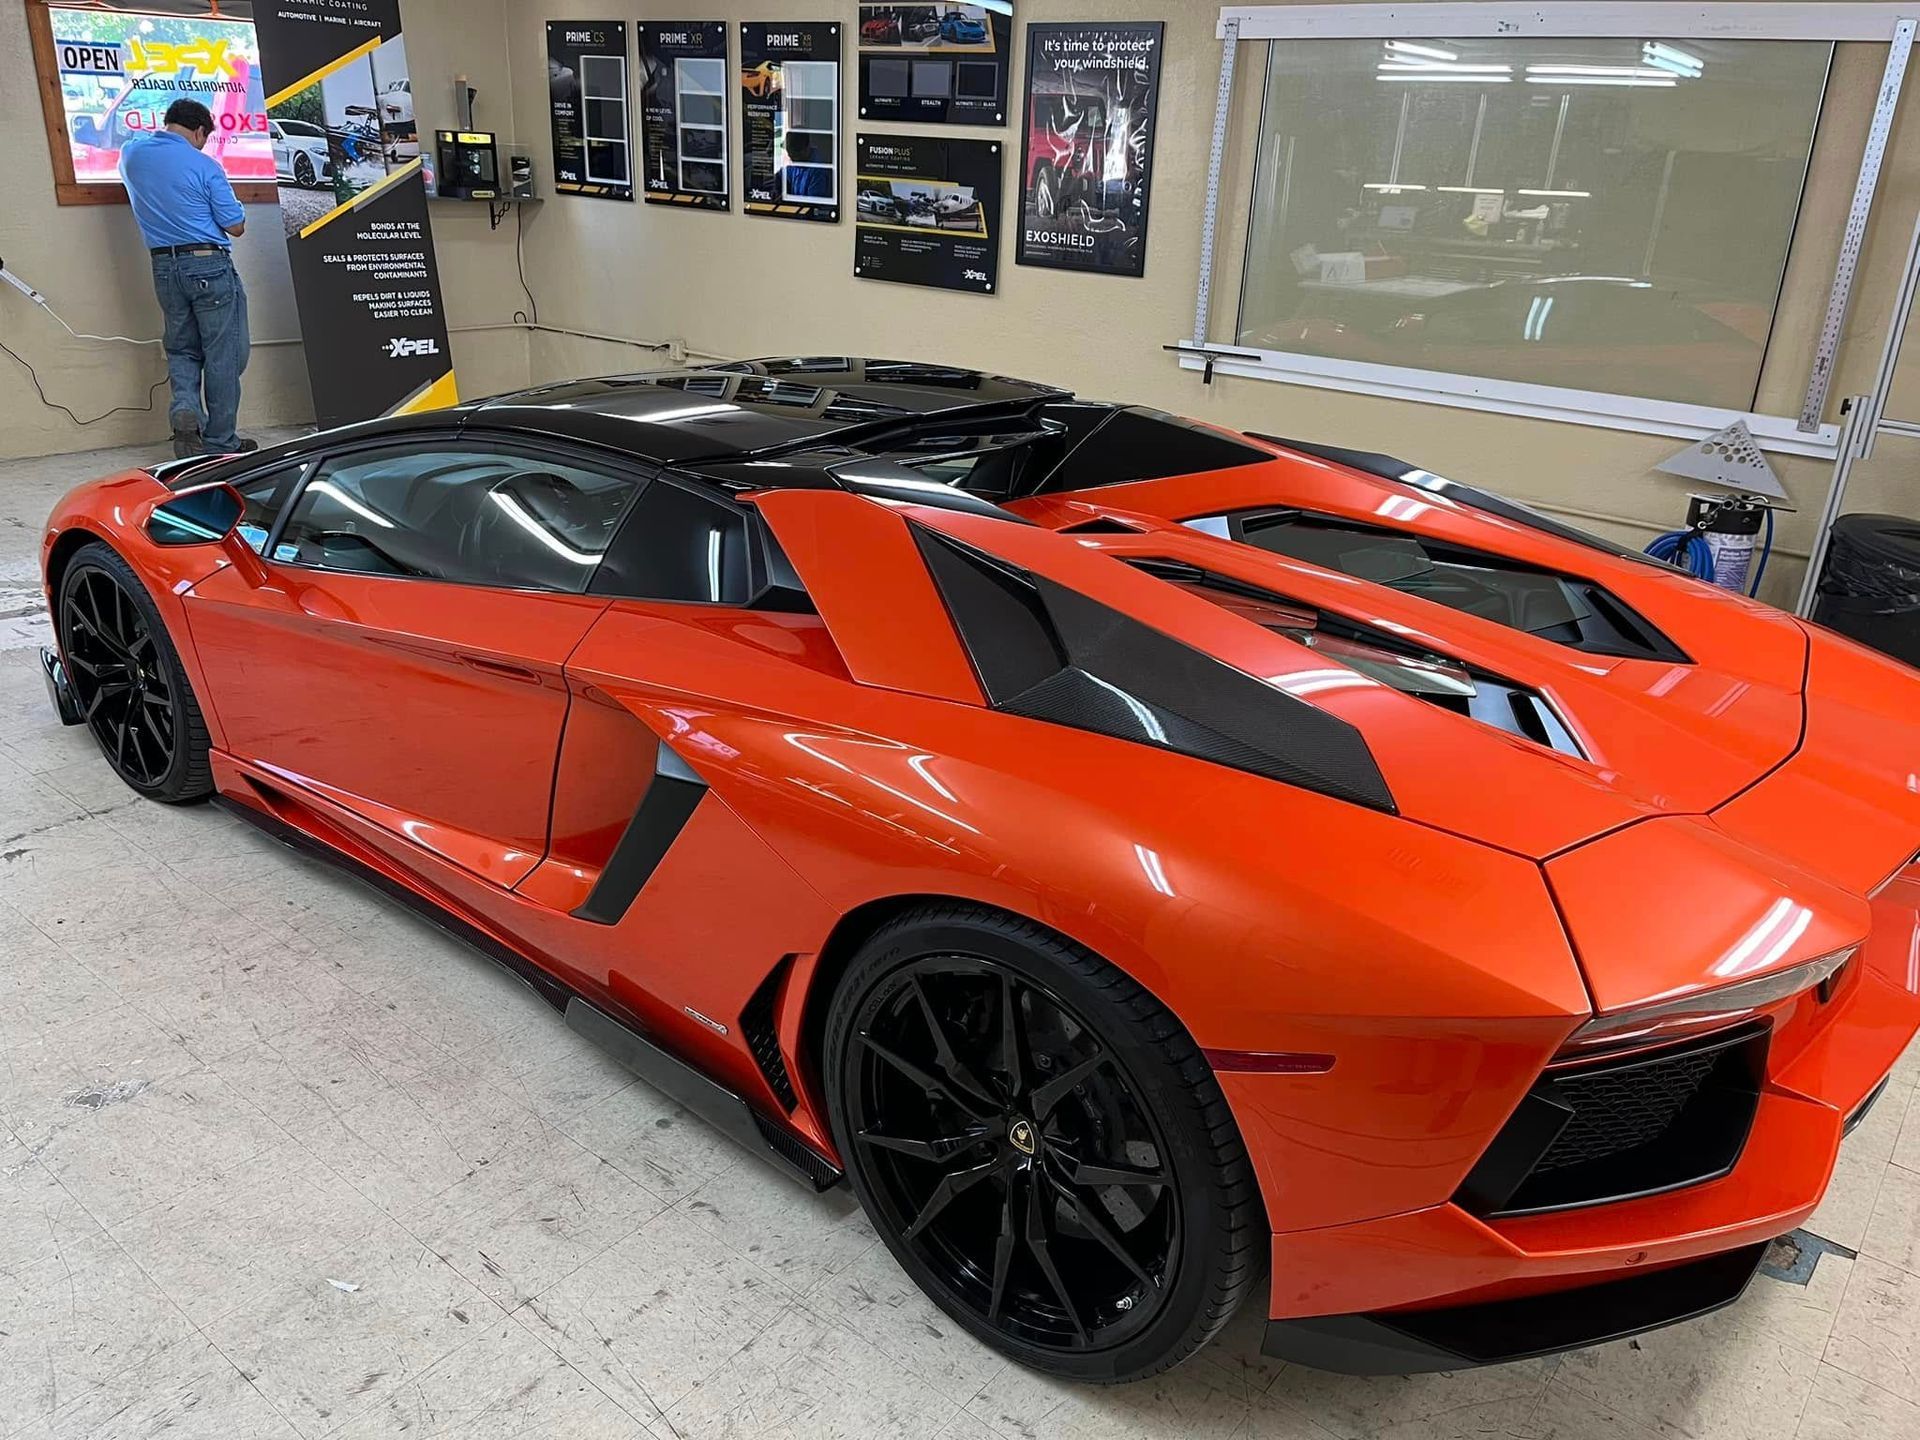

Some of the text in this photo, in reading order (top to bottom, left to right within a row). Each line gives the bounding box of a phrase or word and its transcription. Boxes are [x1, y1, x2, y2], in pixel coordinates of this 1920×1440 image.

[329, 0, 368, 11] COATING
[278, 11, 381, 28] AUTOMOTIVE MARINE AIRCRAFT
[565, 31, 605, 43] PRIME CS
[660, 33, 703, 44] PRIME XR
[766, 34, 799, 47] PRIME
[1044, 40, 1151, 54] It's time to protect
[63, 46, 120, 71] OPEN
[1054, 56, 1150, 71] your windshield.
[869, 146, 893, 155] FUSION
[560, 170, 577, 181] XPEL
[651, 178, 669, 189] XPEL
[750, 188, 771, 200] XPEL
[371, 222, 421, 230] BONDS AT THE
[356, 231, 421, 240] MOLECULAR LEVEL
[1026, 230, 1095, 247] EXOSHIELD
[323, 253, 425, 263] SEALS & PROTECTS SURFACES
[346, 262, 426, 271] FROM ENVIRONMENTAL
[374, 270, 427, 280] CONTAMINANTS
[964, 269, 987, 281] XPEL
[353, 290, 430, 301] REPELS DIRT & LIQUIDS
[368, 299, 432, 310] MAKING SURFACES
[374, 308, 433, 319] EASIER TO CLEAN
[389, 337, 439, 358] XPEL
